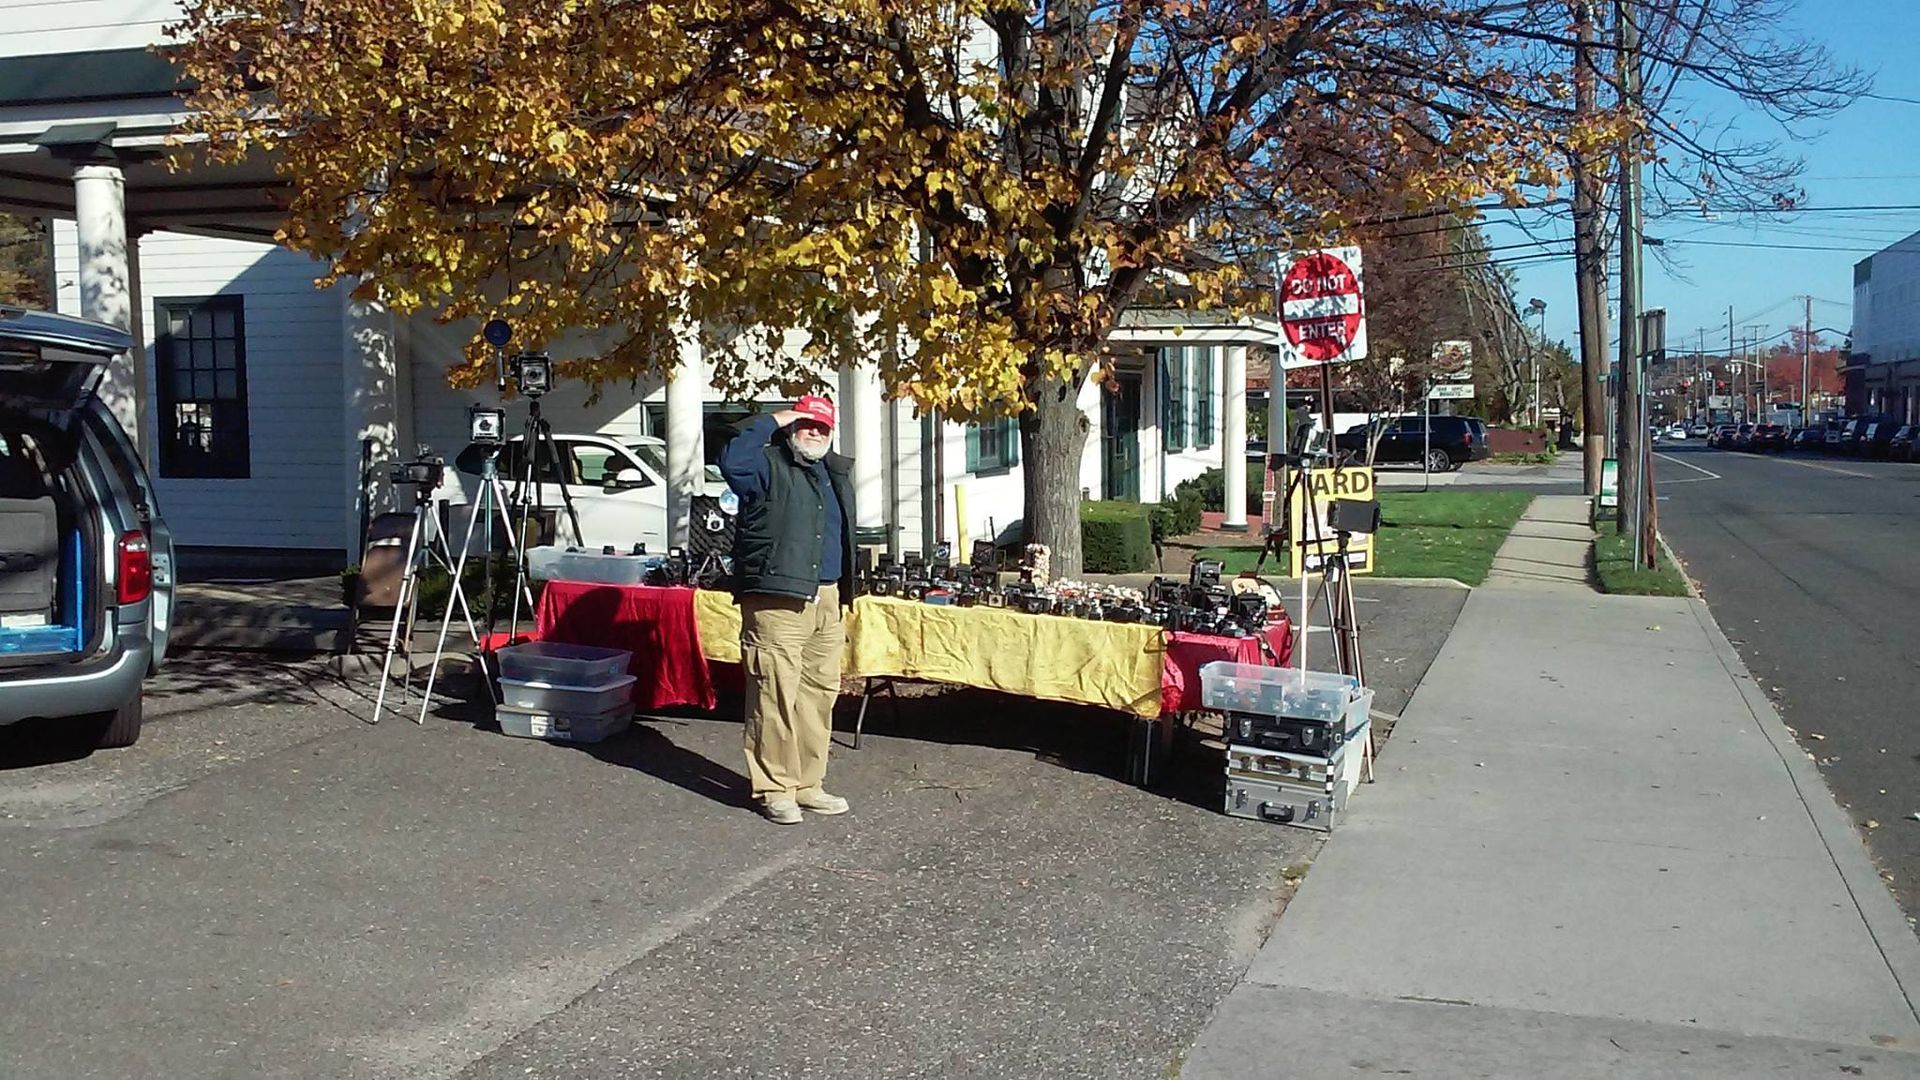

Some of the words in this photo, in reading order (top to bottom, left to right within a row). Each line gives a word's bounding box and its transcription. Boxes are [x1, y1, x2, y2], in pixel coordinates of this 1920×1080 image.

[1291, 278, 1313, 294] DO
[1317, 274, 1347, 292] NOT
[1298, 321, 1347, 341] ENTER
[1302, 471, 1369, 496] ARD
